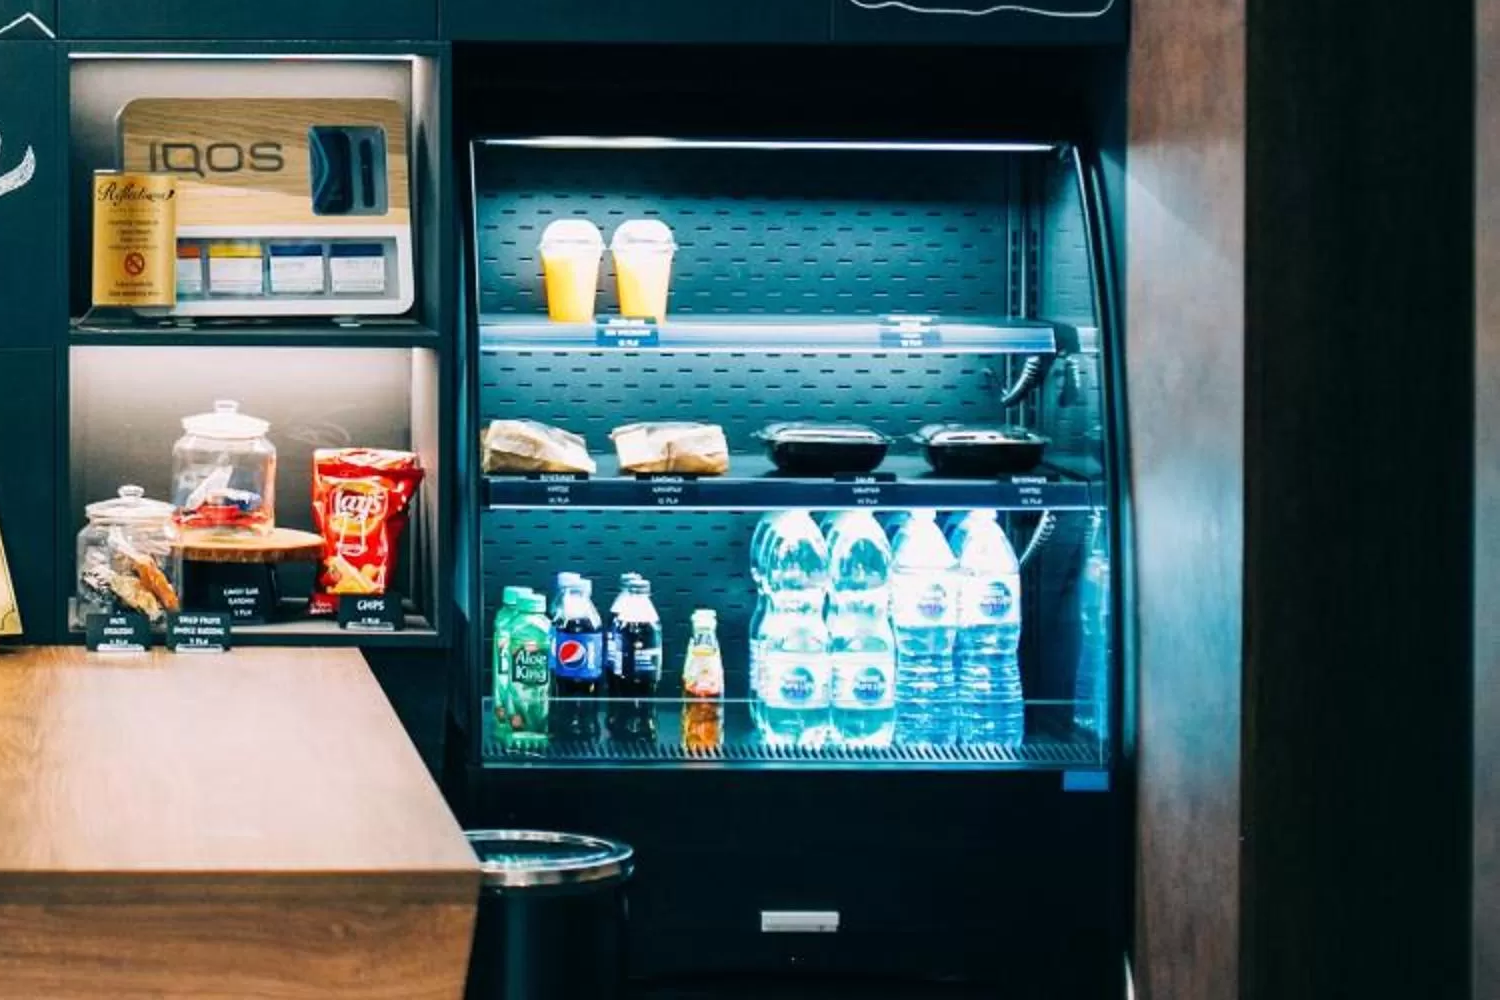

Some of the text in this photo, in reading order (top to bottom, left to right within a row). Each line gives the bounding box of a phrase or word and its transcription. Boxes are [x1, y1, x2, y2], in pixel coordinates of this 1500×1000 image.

[149, 141, 285, 178] IQOS
[515, 649, 547, 665] Aloe
[515, 665, 547, 683] King
